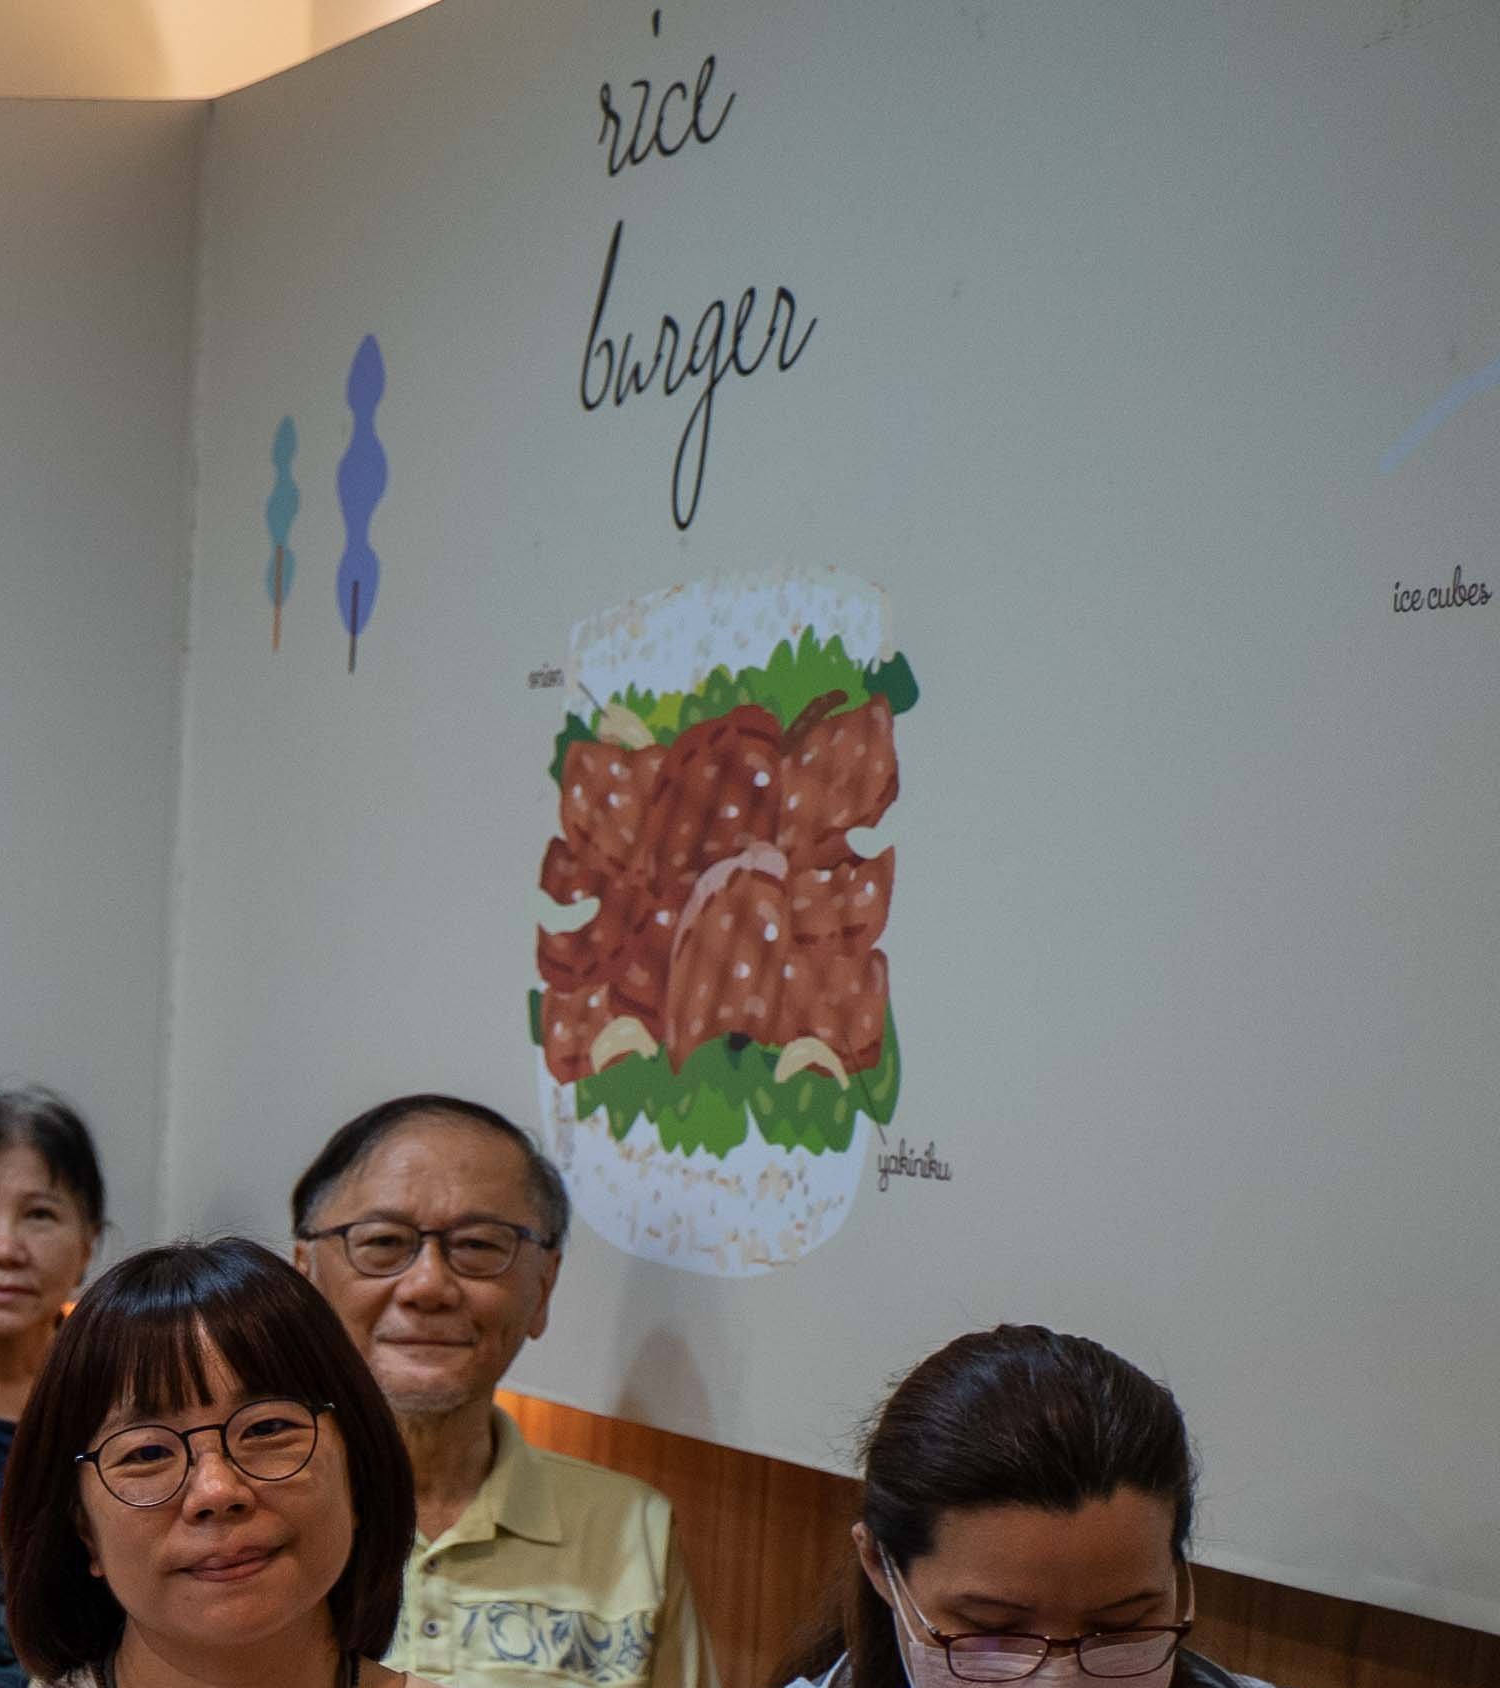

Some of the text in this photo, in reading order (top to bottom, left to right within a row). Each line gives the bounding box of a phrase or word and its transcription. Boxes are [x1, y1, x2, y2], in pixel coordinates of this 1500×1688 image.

[597, 8, 737, 178] rice
[579, 218, 818, 531] burger
[1393, 564, 1493, 613] ice cubes
[877, 1137, 953, 1193] yakiniku
